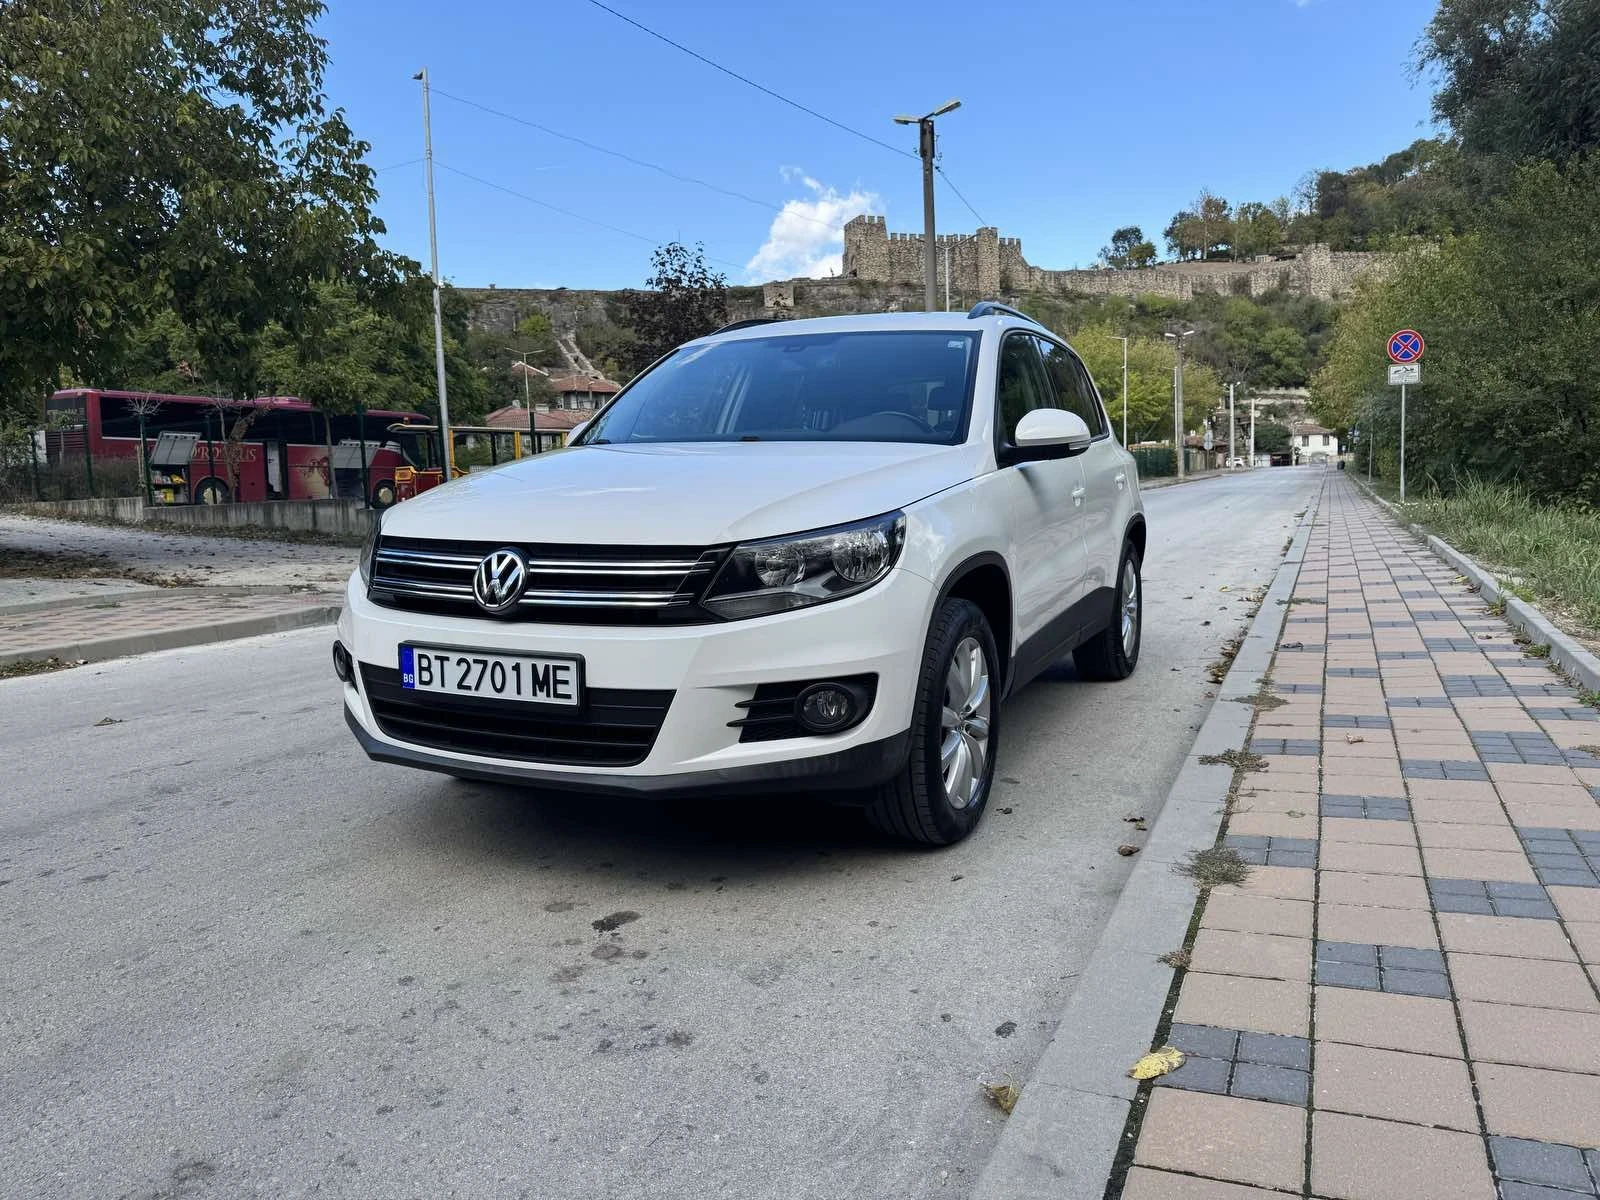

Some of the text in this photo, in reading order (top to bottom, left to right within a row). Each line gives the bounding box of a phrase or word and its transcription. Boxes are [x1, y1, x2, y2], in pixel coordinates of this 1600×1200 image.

[403, 654, 572, 699] BG BT 2701 ME
